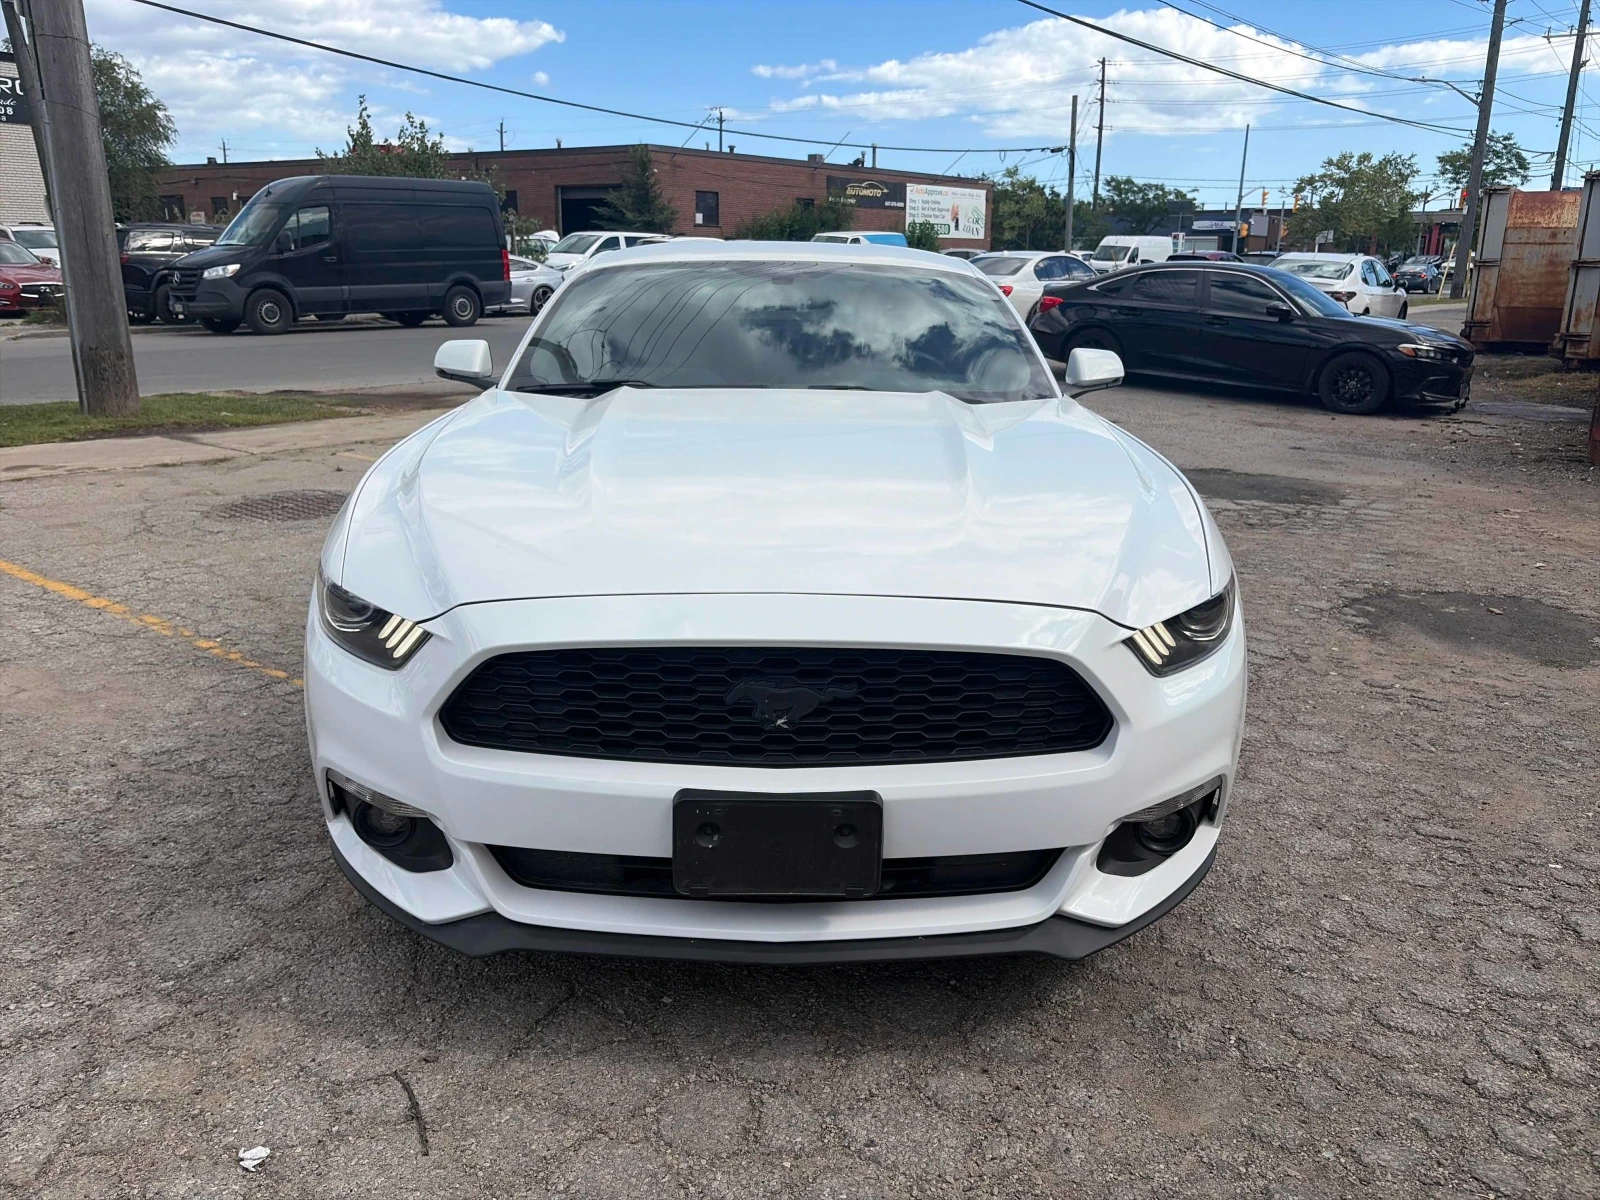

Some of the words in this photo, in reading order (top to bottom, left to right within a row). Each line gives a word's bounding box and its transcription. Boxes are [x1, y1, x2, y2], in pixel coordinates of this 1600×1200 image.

[845, 186, 882, 197] AUTOMOTO
[967, 216, 980, 225] CAR
[962, 224, 980, 237] LOAN
